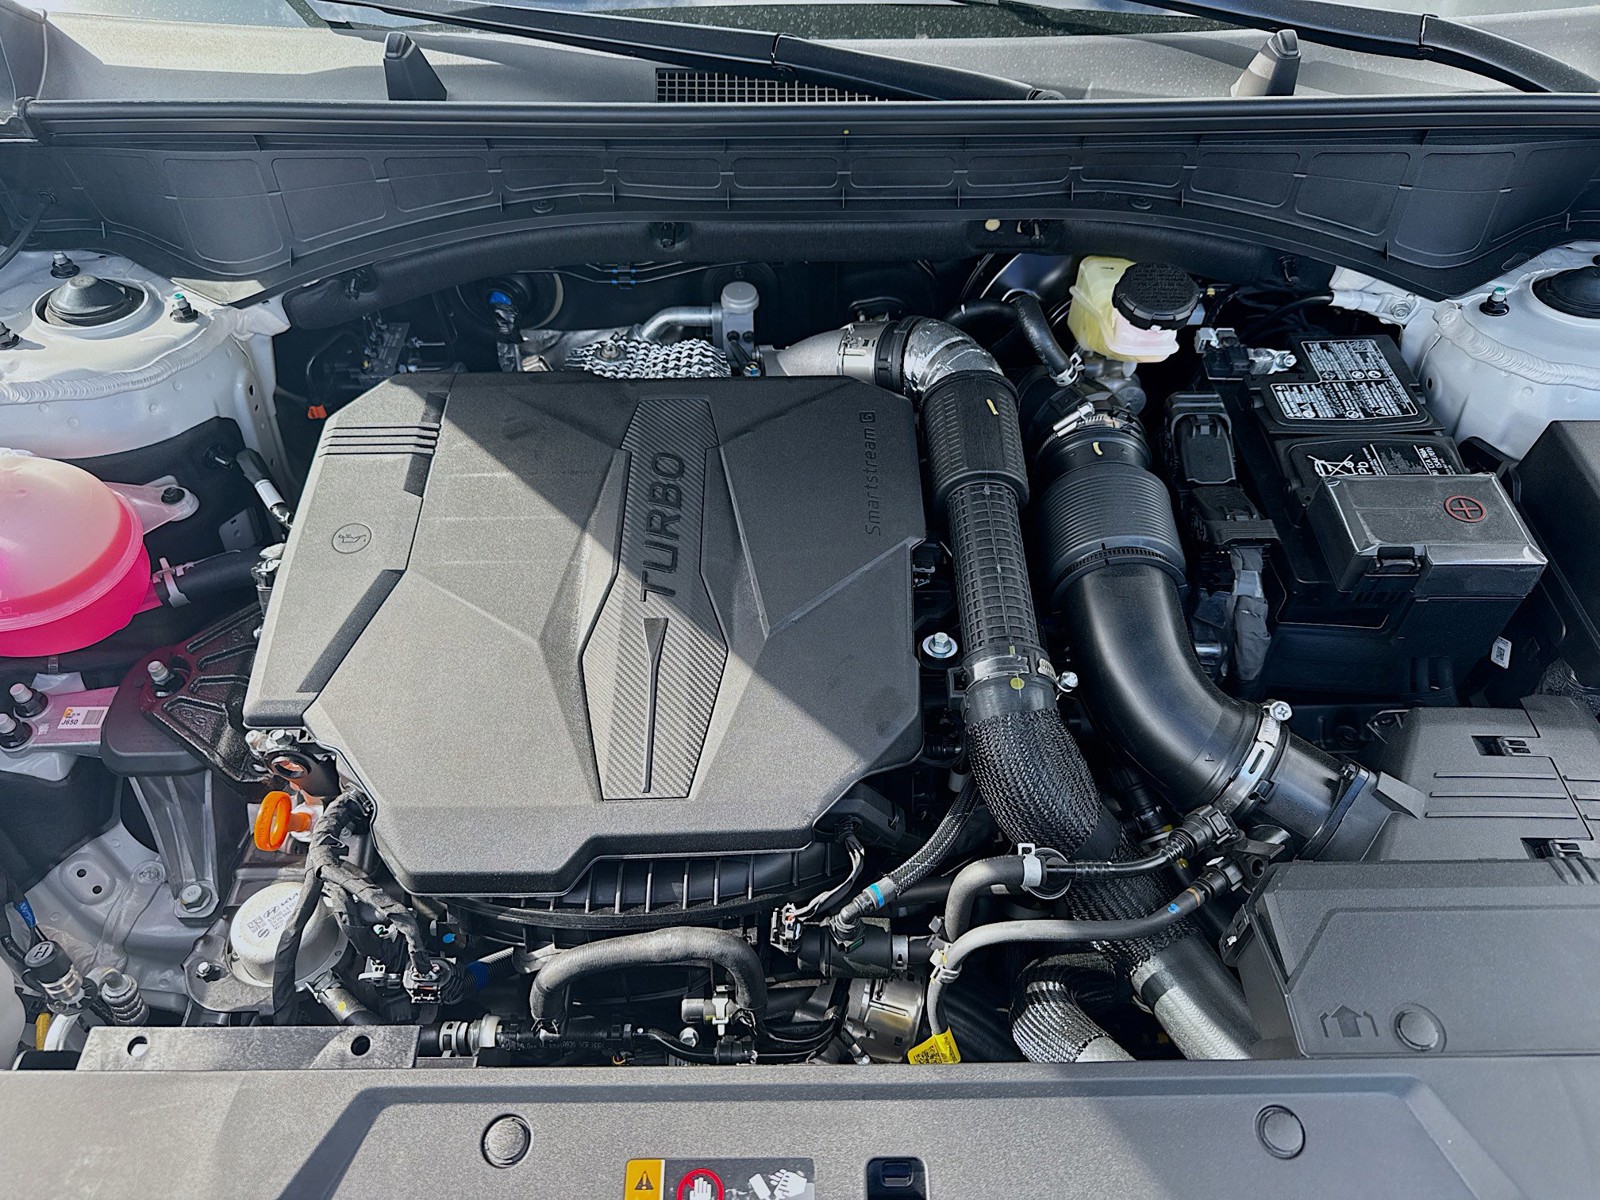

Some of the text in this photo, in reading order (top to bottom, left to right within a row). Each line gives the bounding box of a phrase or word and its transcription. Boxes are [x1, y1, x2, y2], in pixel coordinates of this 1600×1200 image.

[864, 427, 881, 536] Smartstream
[1356, 461, 1372, 475] Pb
[640, 453, 685, 602] TURBO
